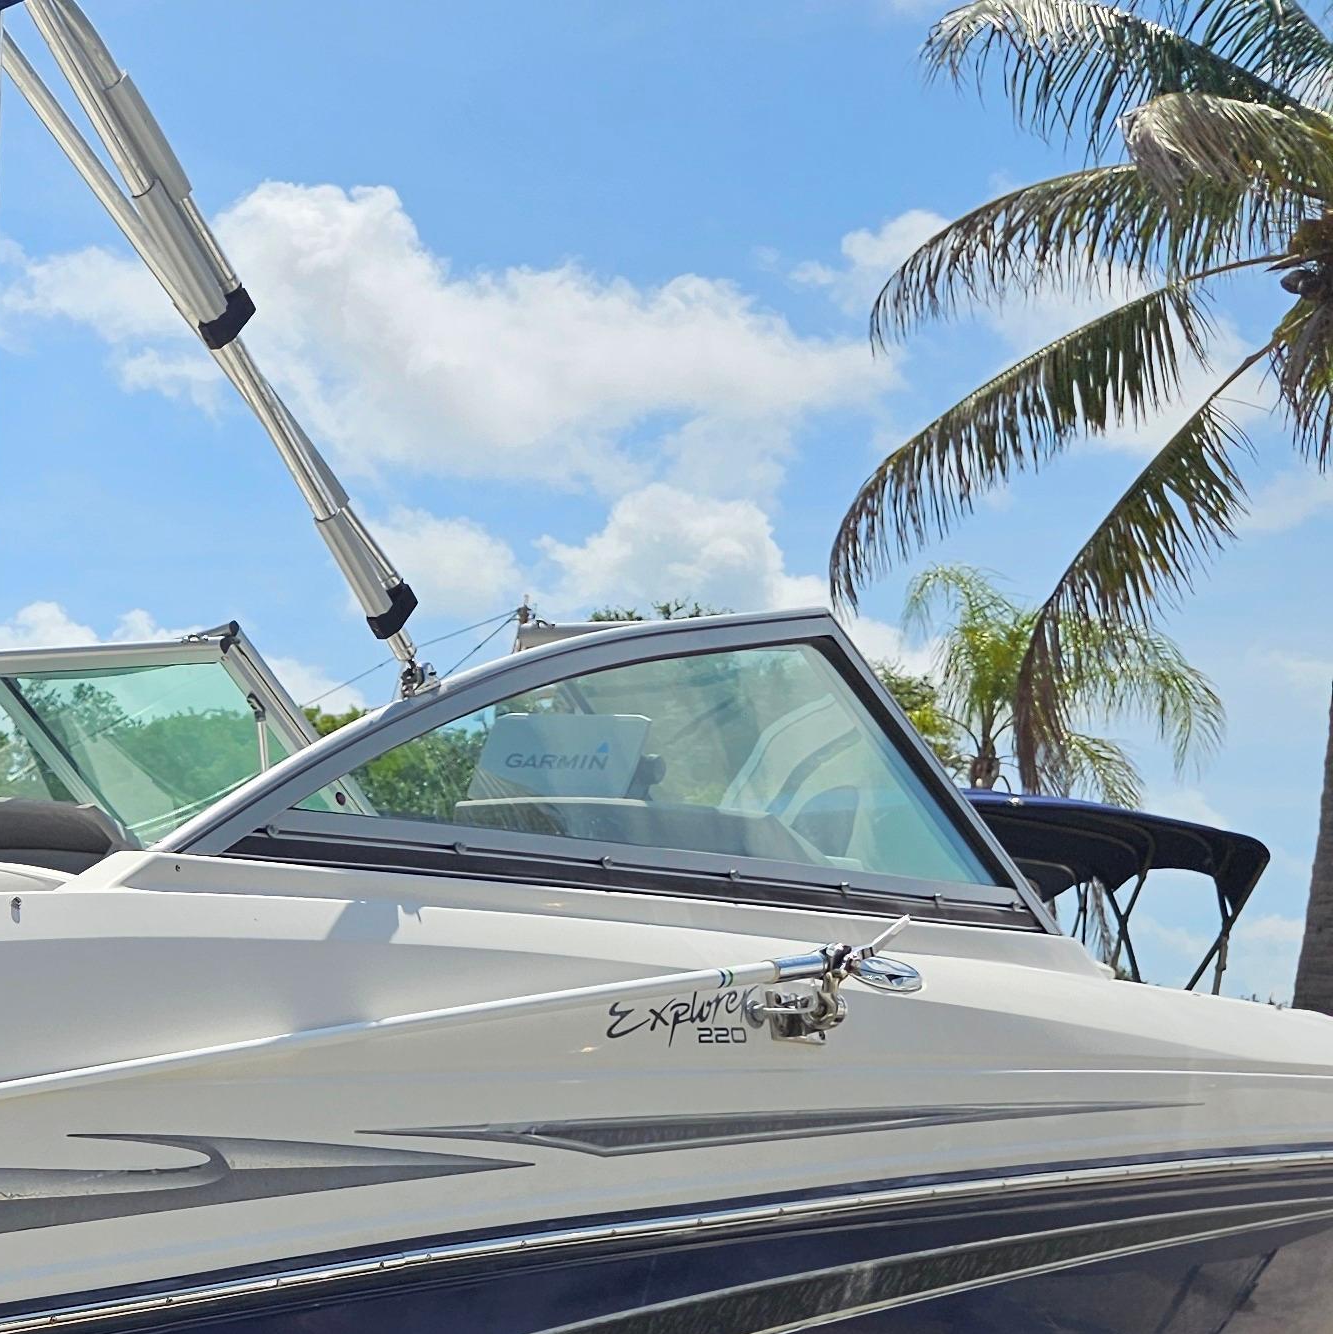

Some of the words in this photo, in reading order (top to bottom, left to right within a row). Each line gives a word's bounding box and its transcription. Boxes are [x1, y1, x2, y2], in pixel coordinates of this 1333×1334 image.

[505, 752, 609, 770] GARMIN
[606, 985, 760, 1048] Explorer
[697, 1027, 747, 1044] 220
